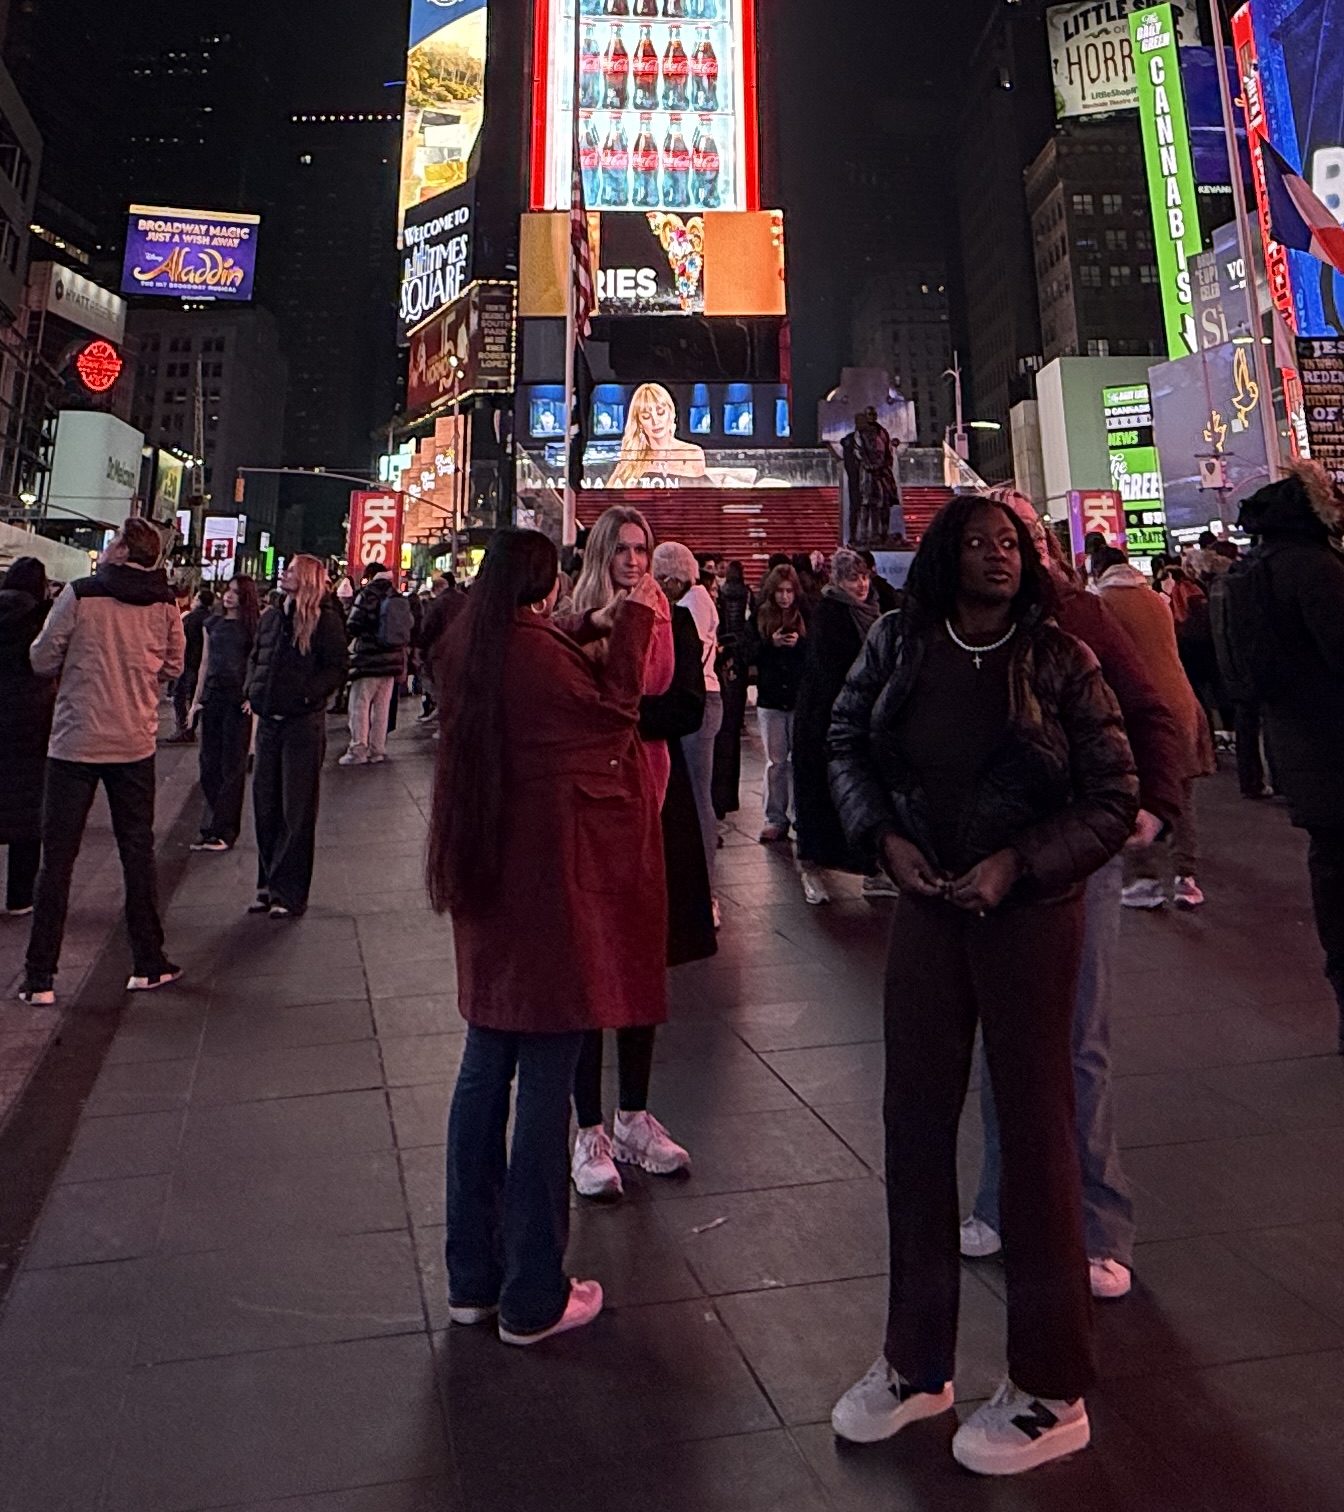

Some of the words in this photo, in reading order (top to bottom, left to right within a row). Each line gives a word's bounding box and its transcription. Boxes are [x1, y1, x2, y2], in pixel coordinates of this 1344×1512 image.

[1137, 21, 1162, 40] DAILY
[1066, 38, 1136, 100] HORR
[1149, 55, 1192, 304] CANNABIS
[138, 219, 208, 235] BROADWAY
[209, 224, 250, 239] MAGIC
[146, 231, 171, 243] JUST
[172, 234, 180, 243] A
[182, 234, 210, 245] WISH
[211, 237, 240, 248] AWAY
[404, 212, 454, 247] WELCOME
[454, 207, 469, 225] TO
[133, 246, 244, 287] Aladdin
[428, 234, 468, 270] TIMES
[400, 259, 466, 323] SQUARE
[1312, 407, 1339, 421] OF
[1107, 431, 1138, 446] NEWS
[1119, 472, 1160, 500] GREE
[360, 495, 397, 566] tkts
[1010, 1399, 1059, 1441] N
